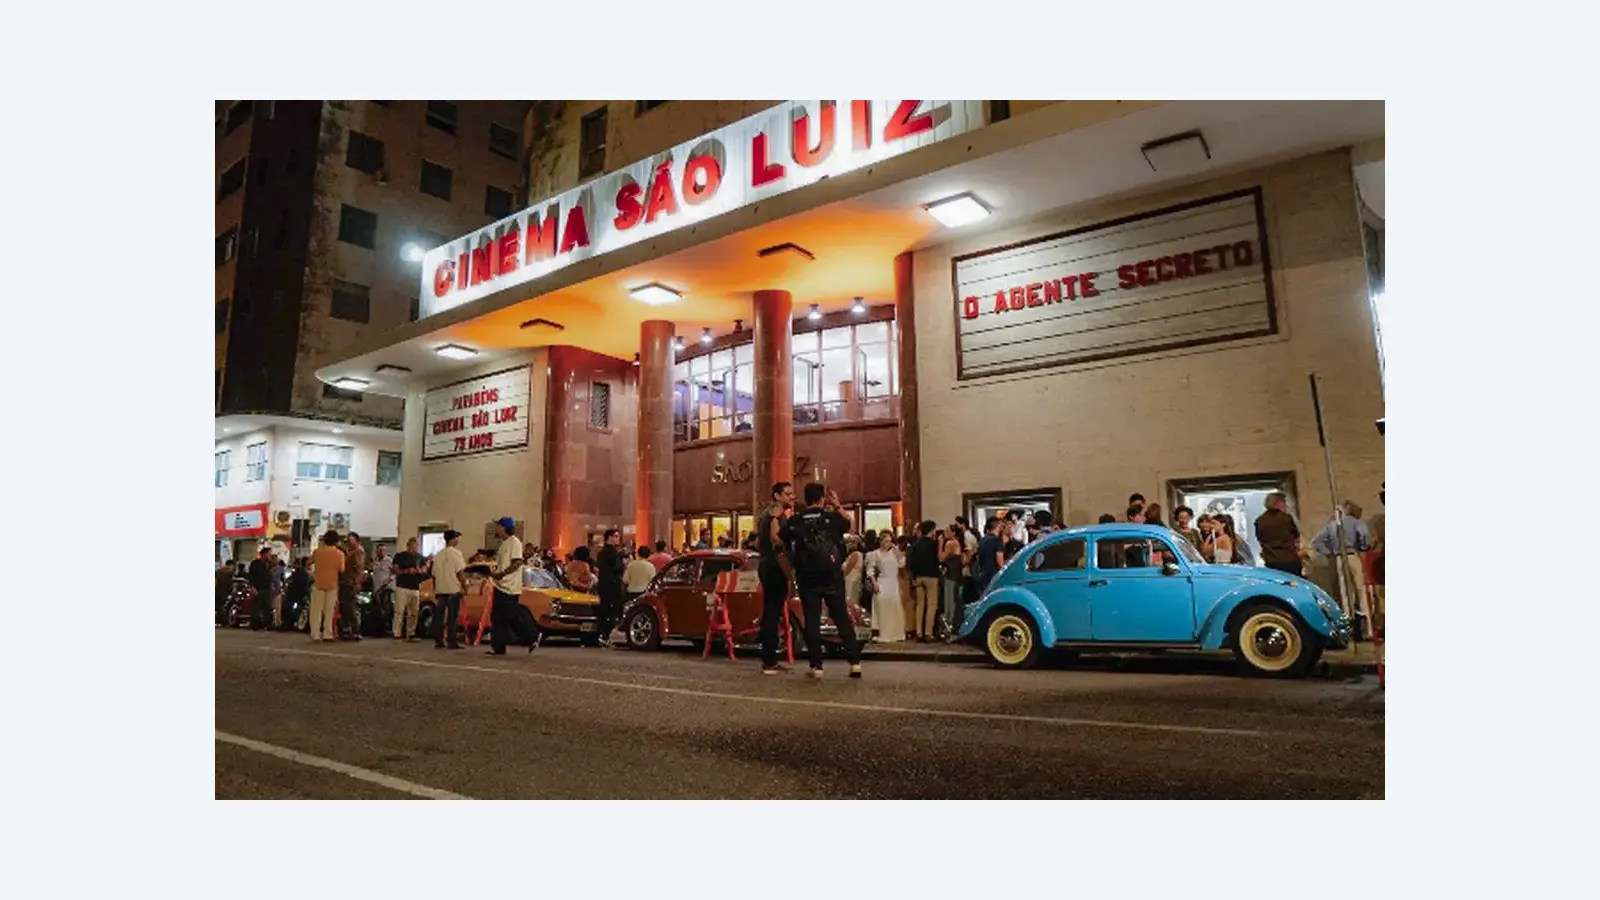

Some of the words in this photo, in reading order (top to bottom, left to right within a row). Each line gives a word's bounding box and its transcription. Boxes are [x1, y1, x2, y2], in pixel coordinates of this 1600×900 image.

[433, 204, 590, 298] CINEMA
[613, 153, 723, 231] SÃO
[963, 296, 980, 320] O
[993, 271, 1100, 314] AGENTE
[1118, 239, 1252, 289] SECRETO
[433, 416, 464, 436] CINEMA
[472, 409, 490, 429] SÃO
[468, 432, 494, 451] ANOS
